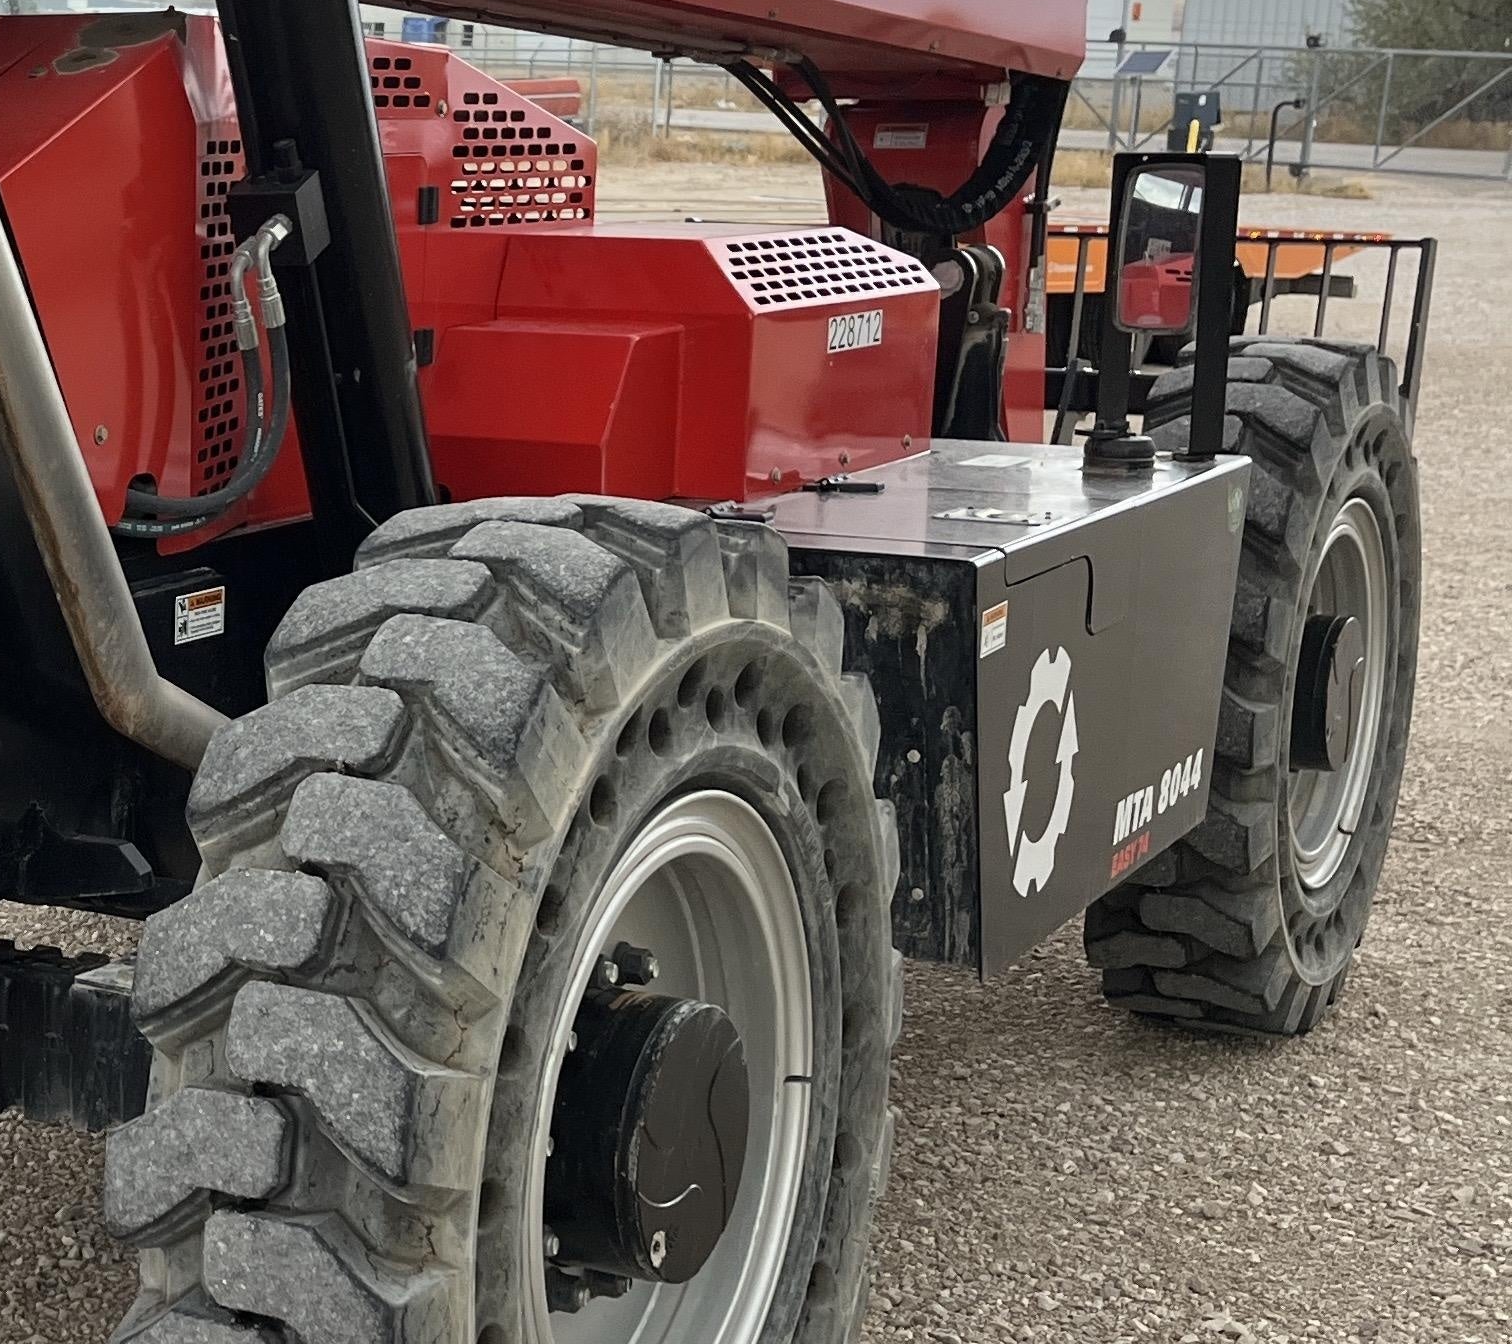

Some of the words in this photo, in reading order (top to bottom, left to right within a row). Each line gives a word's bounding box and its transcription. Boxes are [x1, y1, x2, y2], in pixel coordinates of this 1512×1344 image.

[829, 311, 881, 350] 228712
[1112, 785, 1154, 846] MTA
[1157, 747, 1204, 815] 8044
